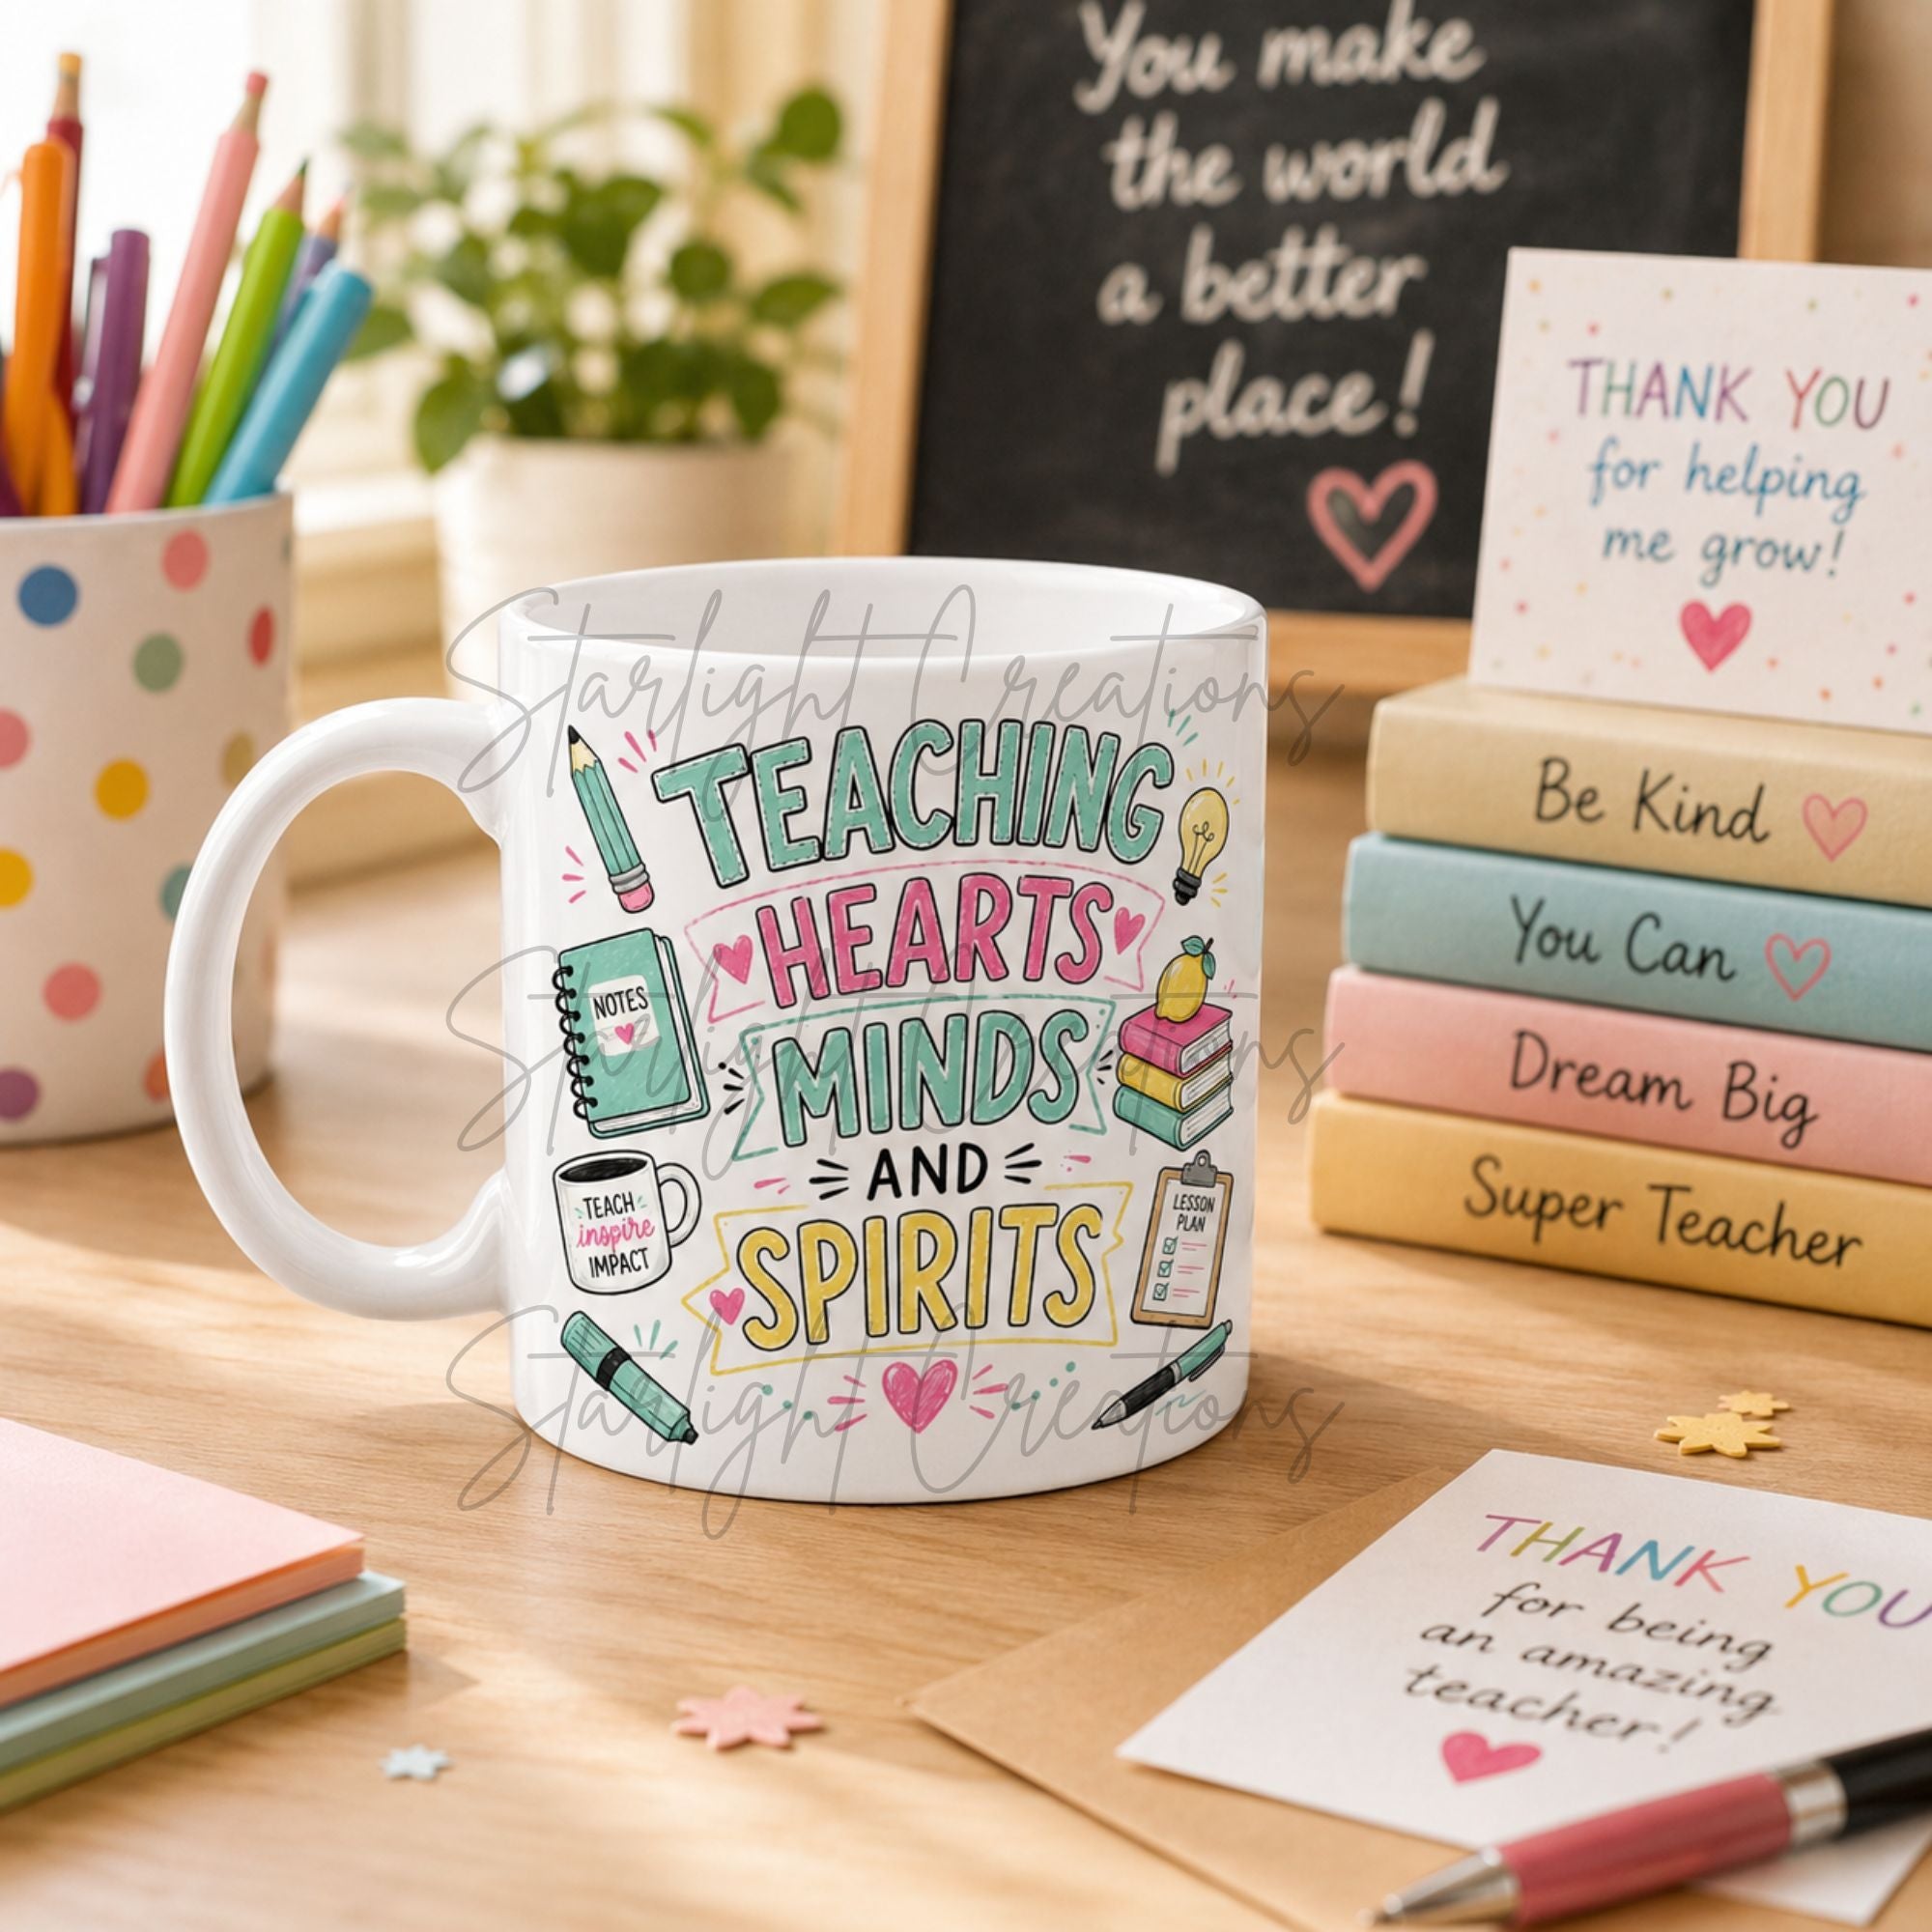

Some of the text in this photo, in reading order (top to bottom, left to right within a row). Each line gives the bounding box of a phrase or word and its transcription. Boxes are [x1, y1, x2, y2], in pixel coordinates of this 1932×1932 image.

[1074, 0, 1487, 114] You make
[1101, 96, 1510, 212] the world
[1097, 222, 1429, 326] a better
[1155, 328, 1435, 476] place!
[1568, 357, 1889, 430] THANK YOU
[1588, 436, 1865, 525] for helping
[1602, 527, 1844, 588] me grow!
[651, 719, 1174, 888] TEACHING
[1534, 757, 1771, 843] Be Kind
[755, 873, 1114, 1009] HEARTS
[1510, 895, 1736, 982] You Can
[592, 986, 649, 1019] NOTES
[772, 1009, 1089, 1147] MINDS
[1510, 1030, 1819, 1150] Dream Big
[582, 1192, 636, 1220] TEACH
[867, 1142, 988, 1201] AND
[1173, 1194, 1215, 1213] LESSON
[1463, 1154, 1862, 1268] Super Teacher
[577, 1217, 655, 1251] inspire
[588, 1247, 649, 1278] IMPACT
[1177, 1213, 1206, 1233] PLAN
[736, 1204, 1103, 1351] SPIRITS
[1476, 1514, 1932, 1629] THANK YOU
[1480, 1581, 1774, 1674] for being
[1404, 1663, 1701, 1753] teacher!
[1419, 1623, 1776, 1728] an amazing
